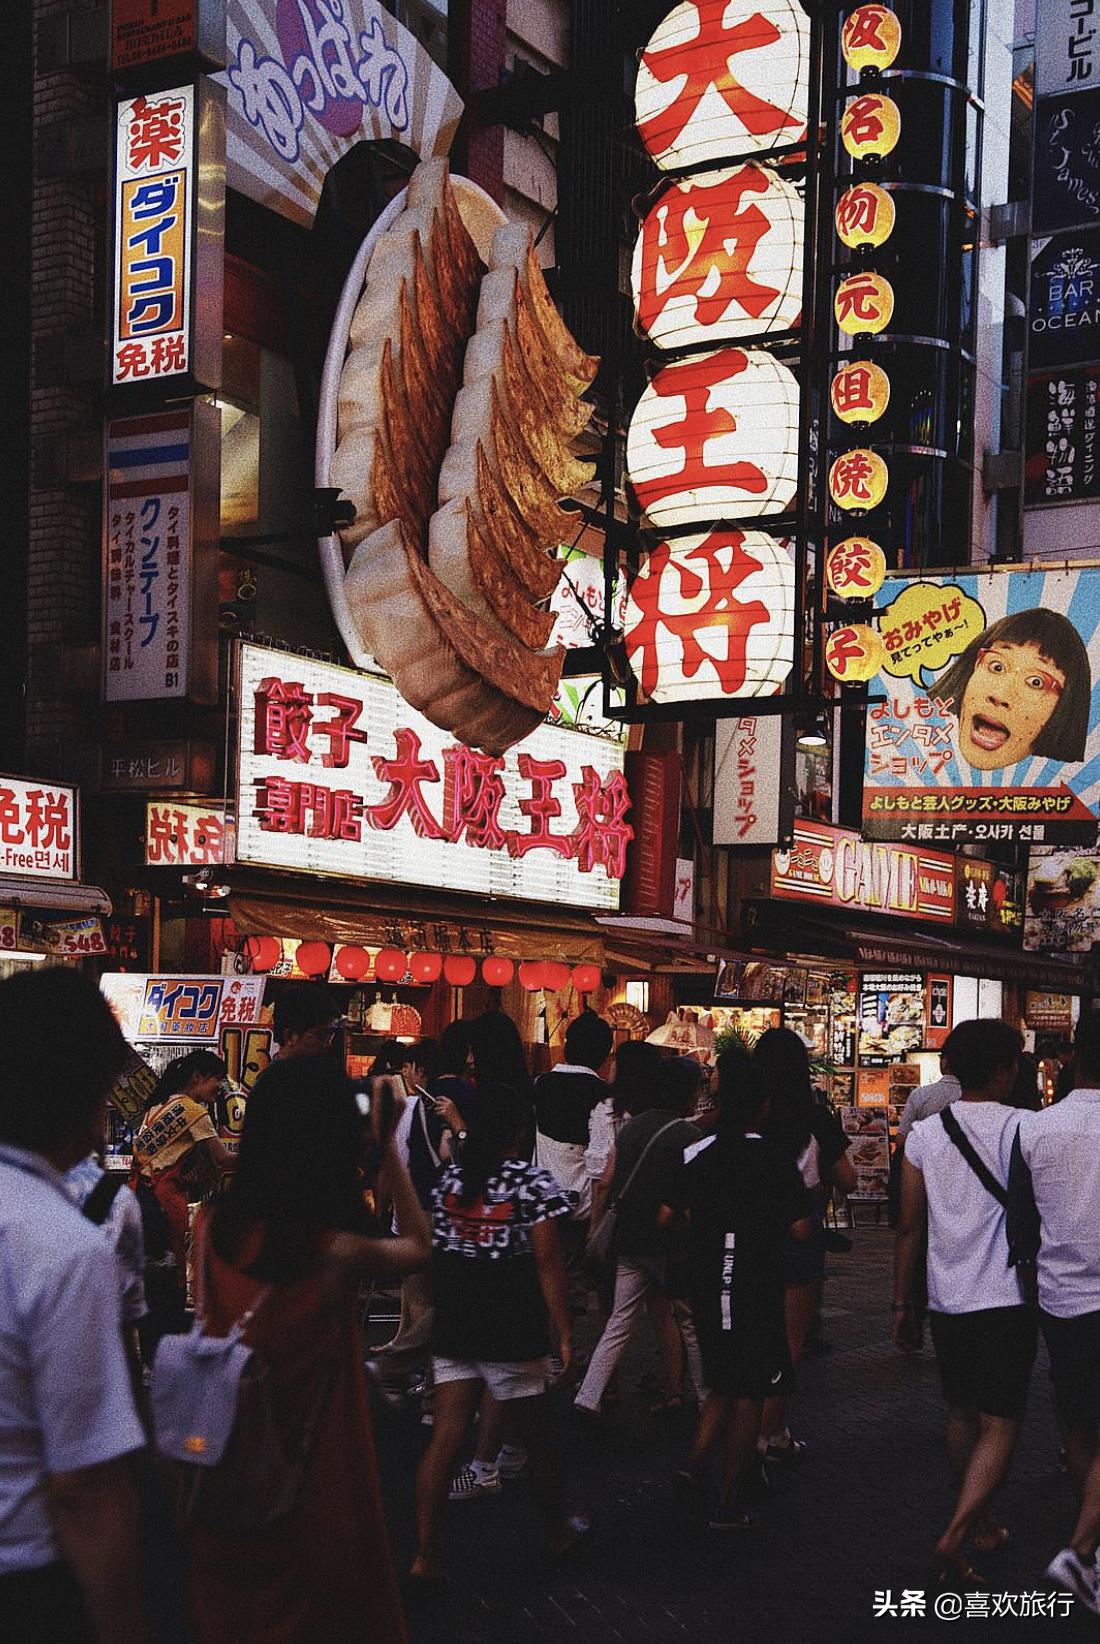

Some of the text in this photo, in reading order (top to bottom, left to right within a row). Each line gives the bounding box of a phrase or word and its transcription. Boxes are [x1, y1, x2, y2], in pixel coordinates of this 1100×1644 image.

[129, 96, 183, 168] 薬
[128, 177, 180, 333] ダイコク
[1049, 280, 1094, 301] BAR
[116, 335, 186, 381] 免税
[882, 597, 963, 652] おみやげ
[165, 672, 179, 688] B1
[870, 696, 954, 721] よしもと
[254, 677, 367, 768] 餃子
[871, 723, 954, 749] エンタメ
[870, 750, 953, 775] ショップ
[0, 789, 71, 851] 免税
[1019, 824, 1046, 841] 선물
[34, 850, 69, 873] 면세
[835, 837, 918, 912] GAME
[64, 931, 104, 952] 548
[148, 984, 219, 1018] ダイコク
[220, 996, 256, 1022] 免税
